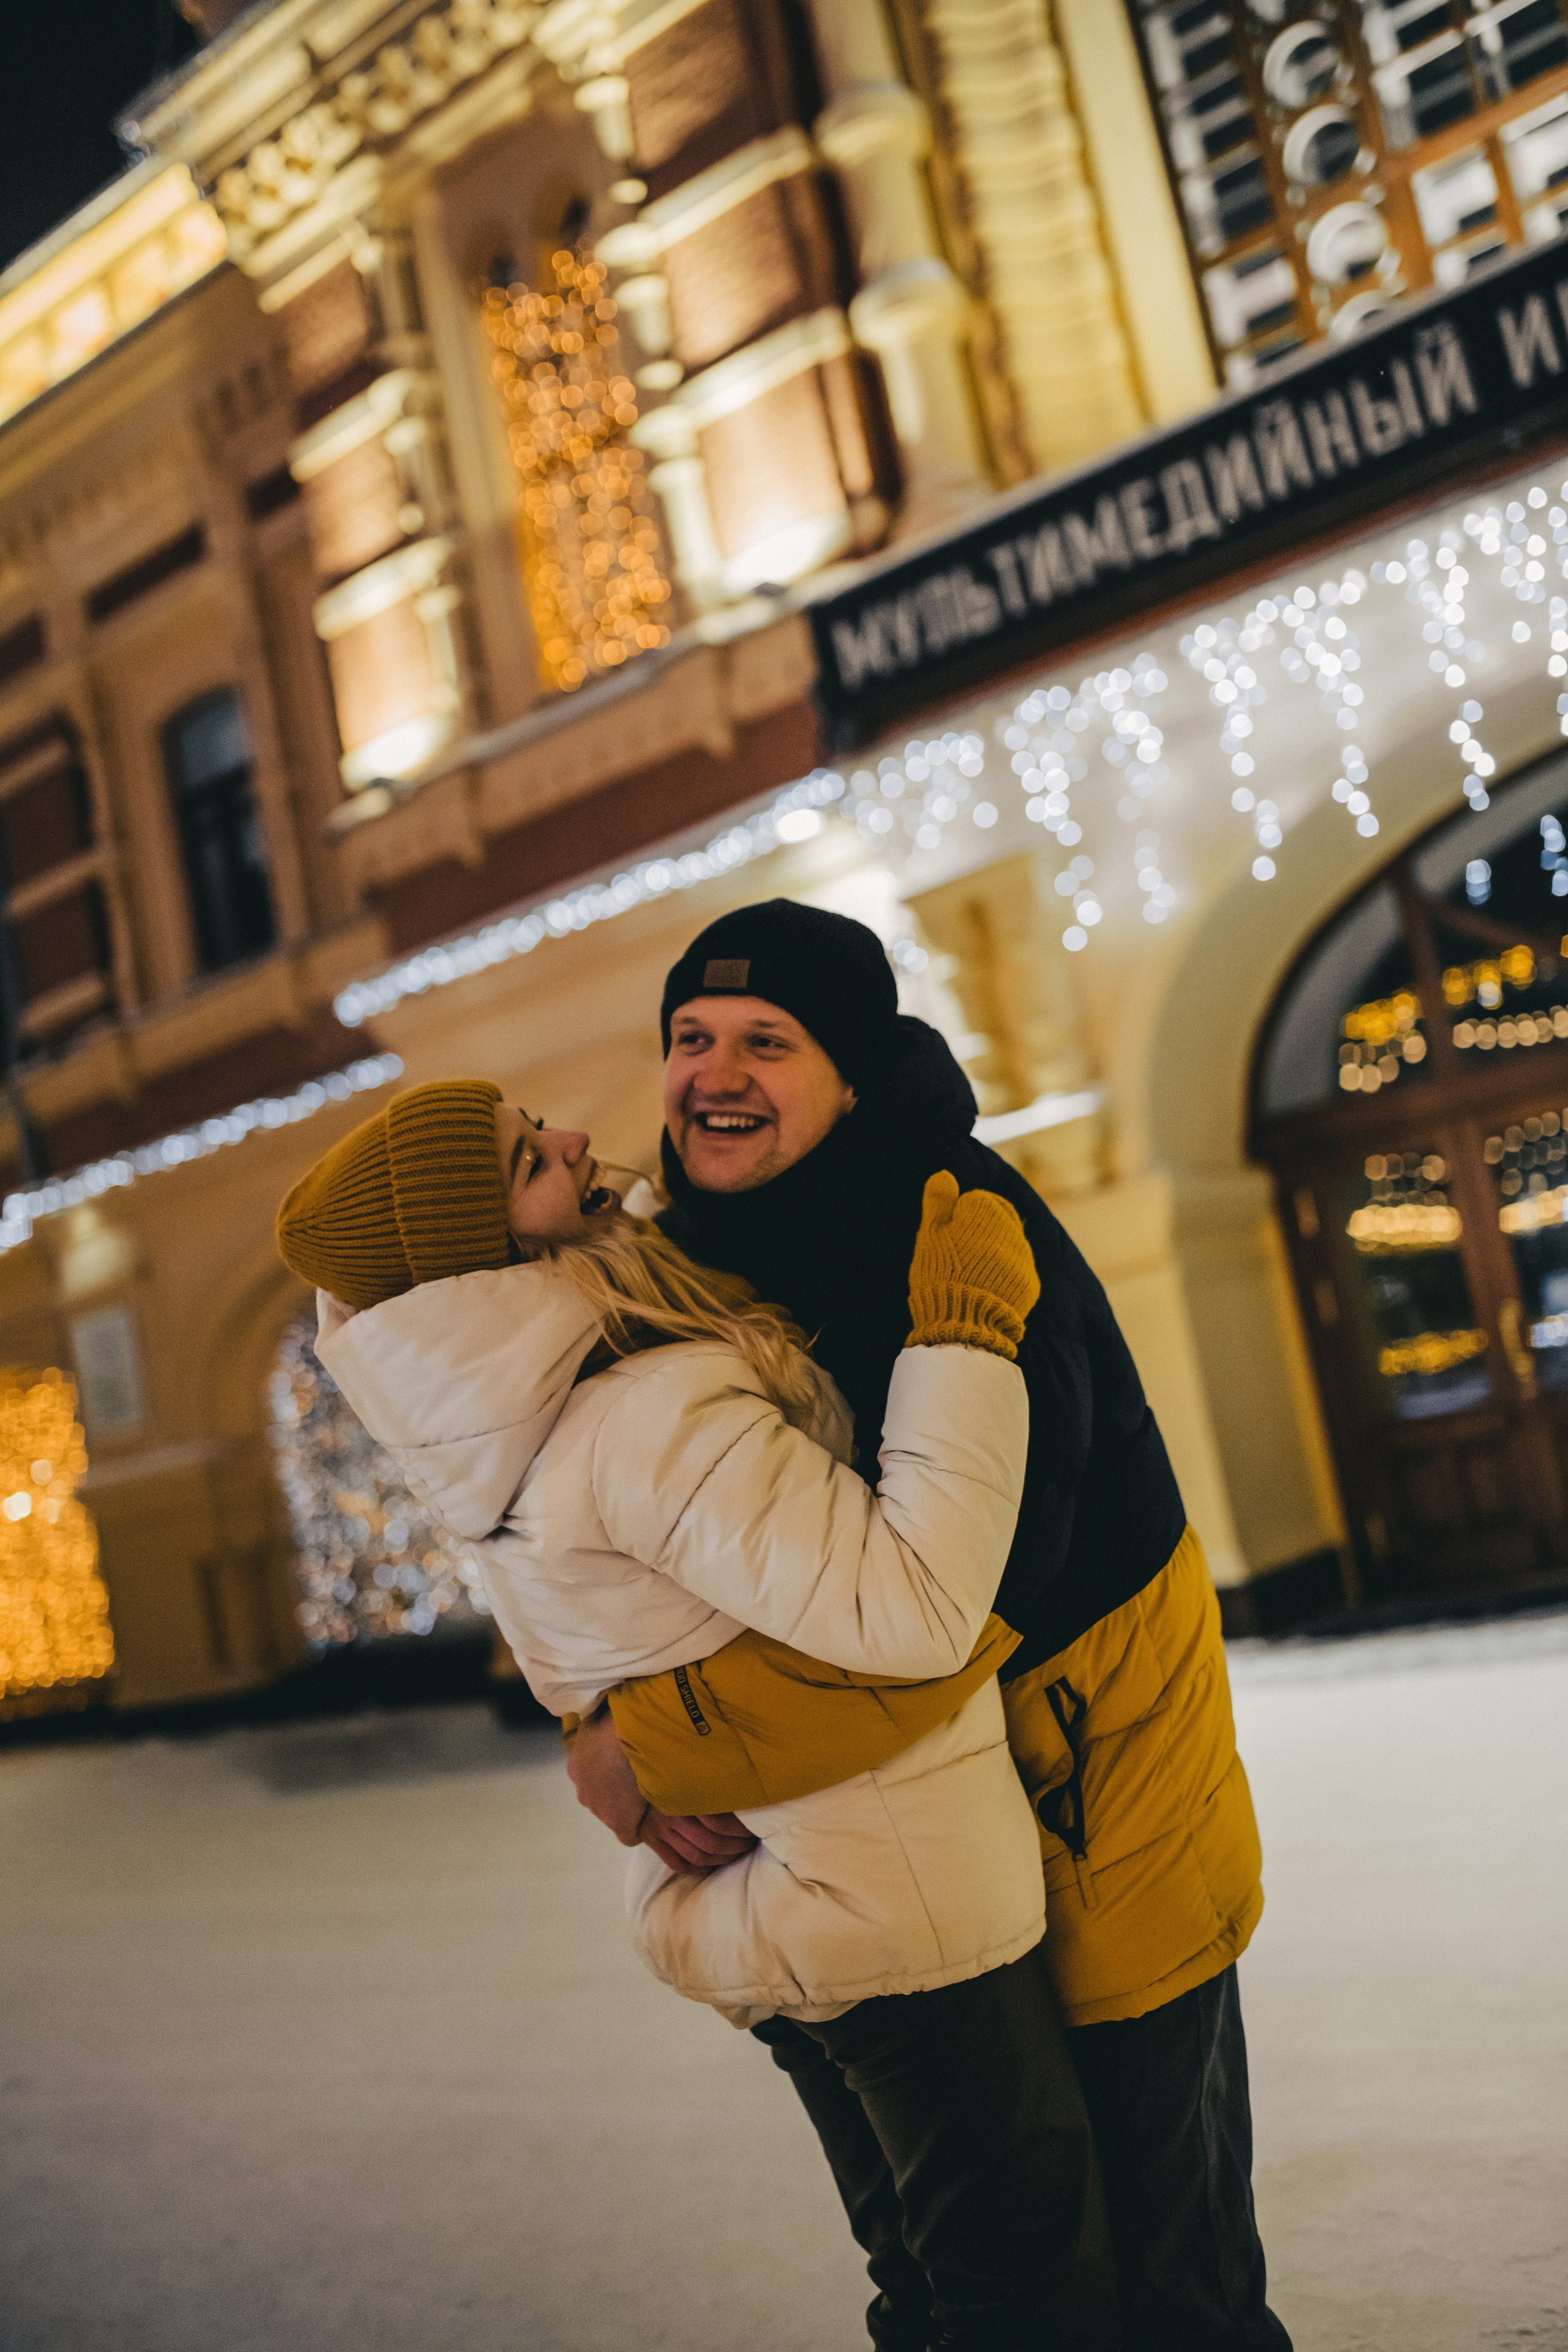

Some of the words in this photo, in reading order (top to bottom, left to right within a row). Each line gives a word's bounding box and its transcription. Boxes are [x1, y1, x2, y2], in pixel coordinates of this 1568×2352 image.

[832, 323, 1477, 688] МУЛЬТИМЕДИЙНЫЙ
[1499, 282, 1568, 386] И
[680, 1684, 700, 1718] SHIELD
